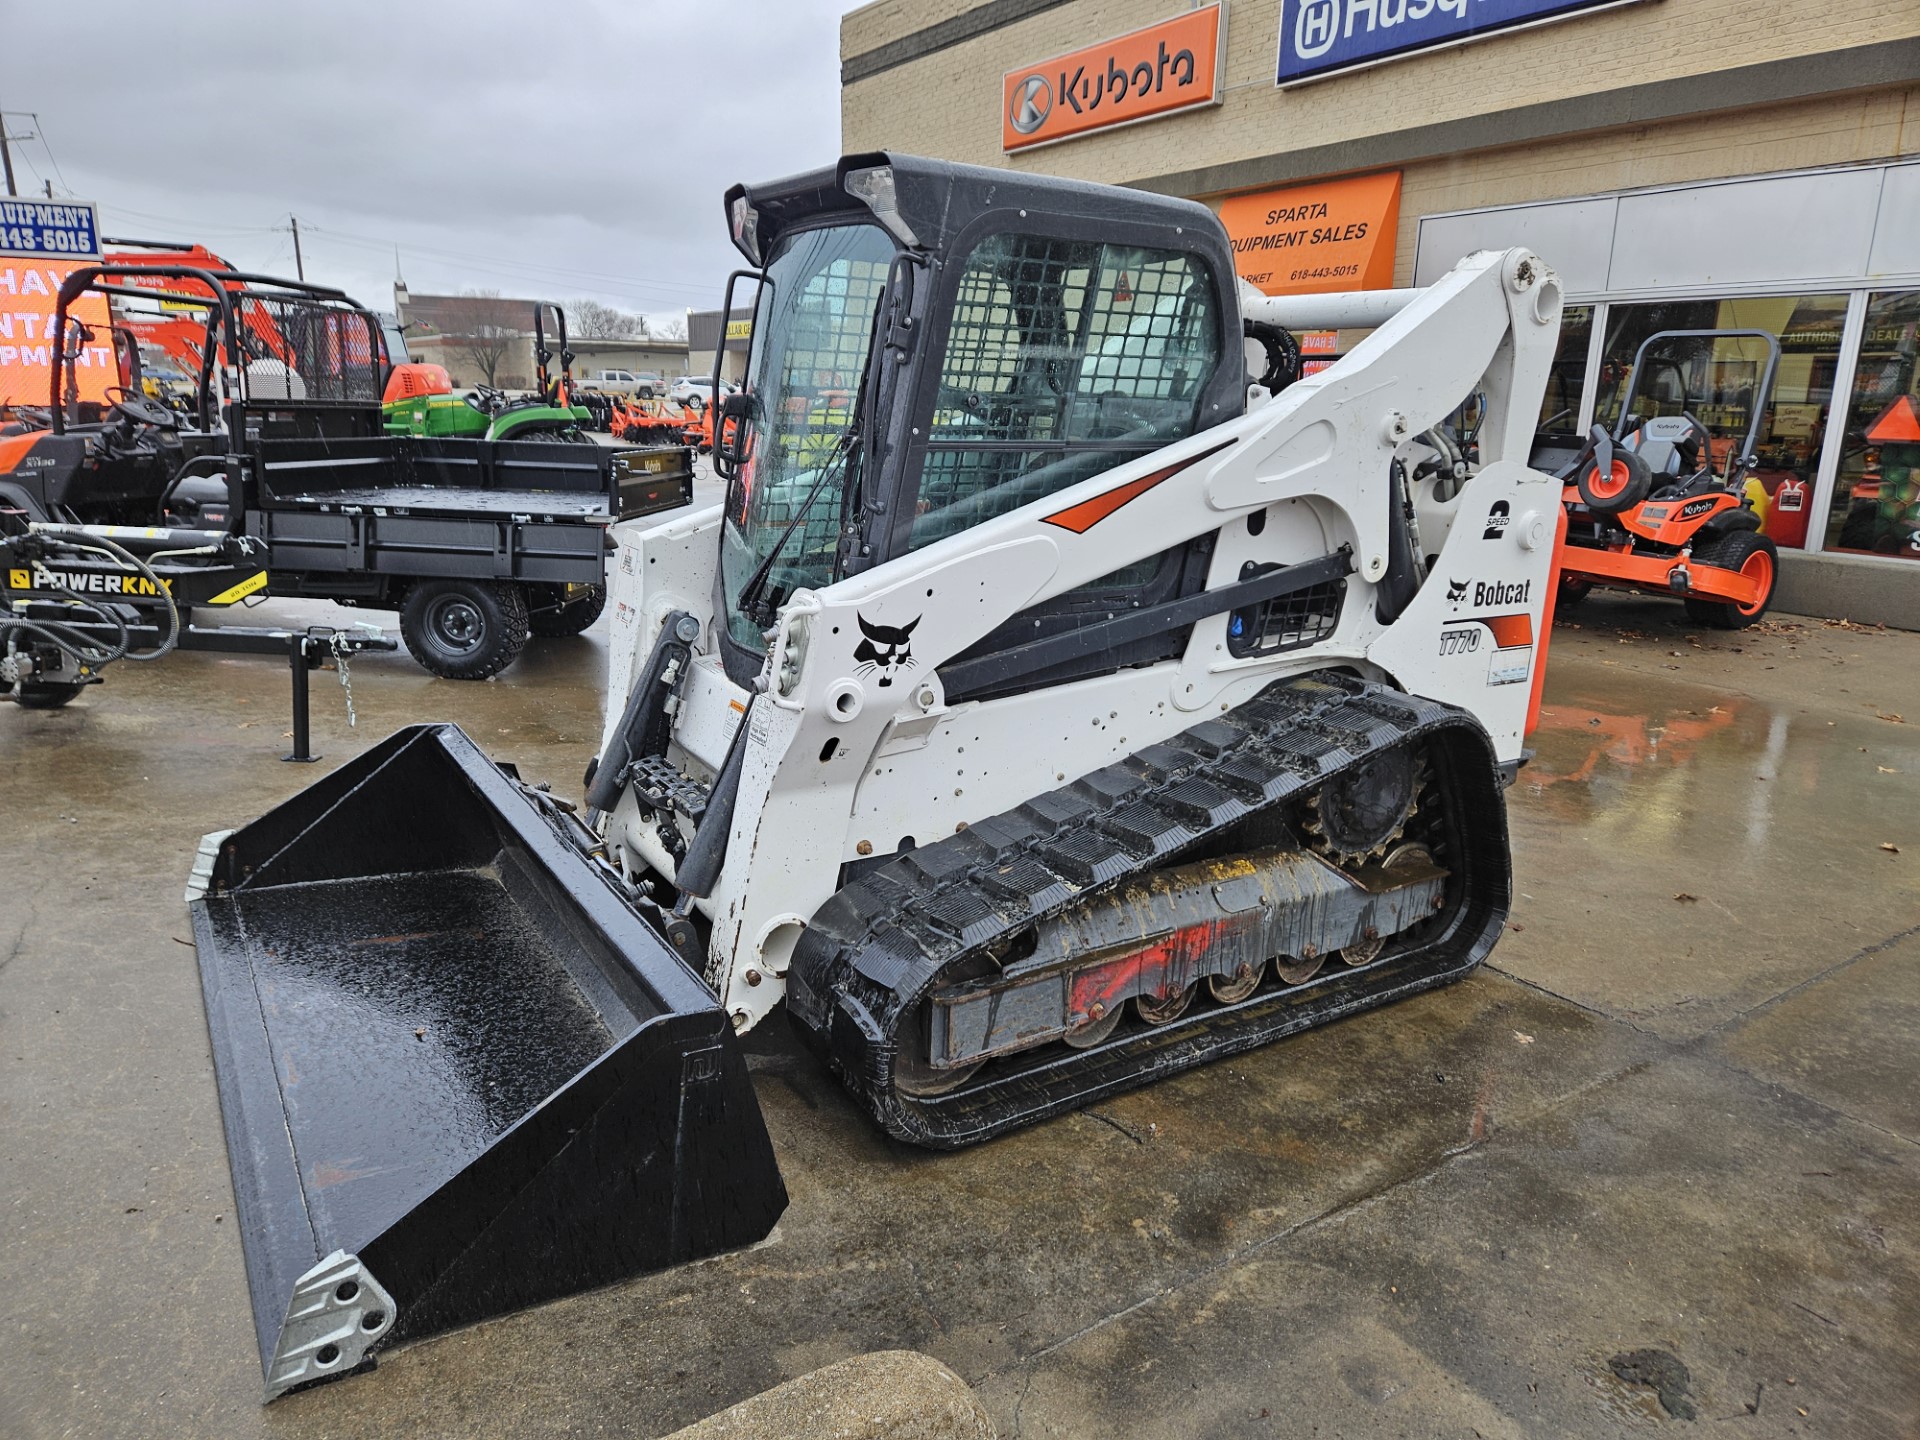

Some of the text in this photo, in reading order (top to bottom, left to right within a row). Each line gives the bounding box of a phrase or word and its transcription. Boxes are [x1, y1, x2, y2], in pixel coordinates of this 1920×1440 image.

[1060, 41, 1195, 114] Kubota
[1266, 203, 1328, 225] SPARTA
[1310, 223, 1368, 244] SALES
[0, 268, 102, 298] HAV
[1290, 264, 1359, 281] 618-443-5015
[0, 313, 83, 339] NTA
[726, 324, 743, 336] LLAR
[1868, 329, 1909, 342] DEALE
[0, 345, 110, 368] PMNT
[1684, 502, 1713, 514] Kubota
[1486, 516, 1510, 527] SPEED
[1474, 579, 1530, 608] Bobcat
[1439, 628, 1482, 656] T770
